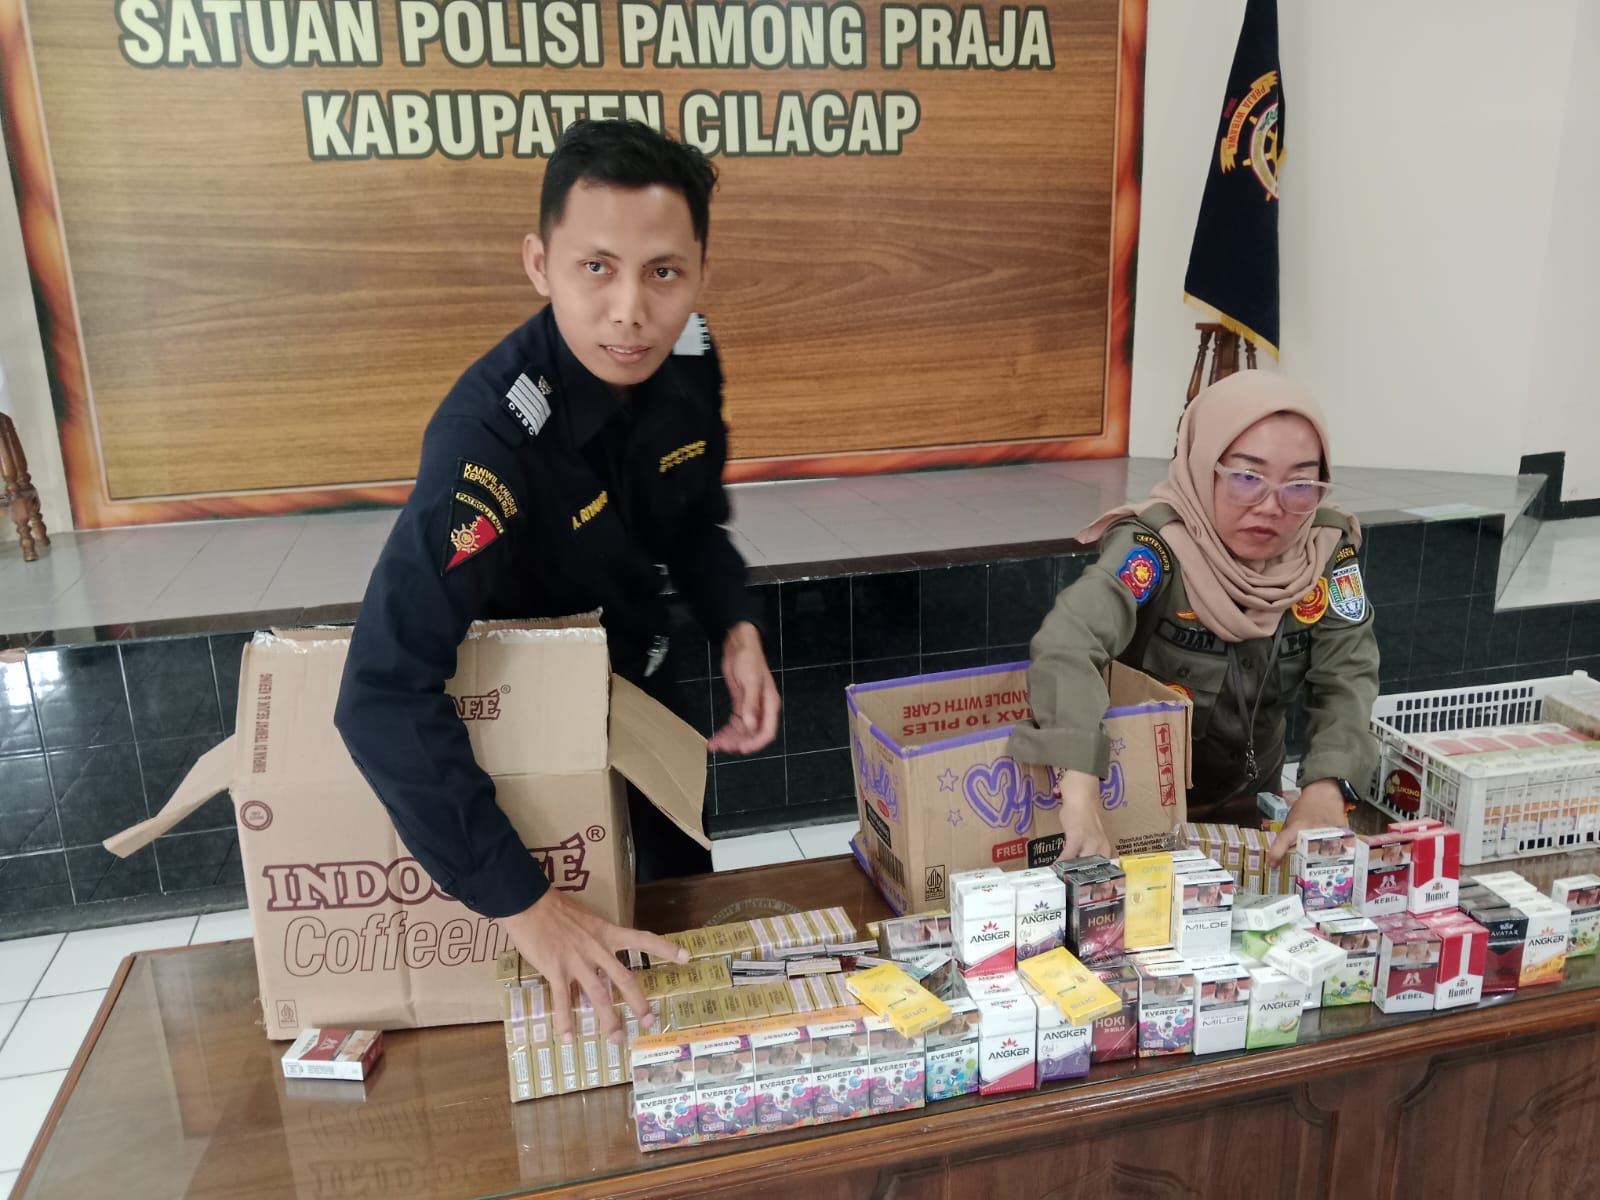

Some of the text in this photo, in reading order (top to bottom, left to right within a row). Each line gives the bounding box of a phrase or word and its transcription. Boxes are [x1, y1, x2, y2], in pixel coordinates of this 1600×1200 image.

[118, 0, 1055, 70] SATUAN POLISI PAMONG PRAJA
[1242, 84, 1267, 109] PRAJA
[681, 90, 921, 157] CILACAP
[1226, 112, 1247, 150] WIBAWA
[465, 462, 499, 487] KANWIL
[463, 471, 504, 503] KEPULAUAN
[258, 673, 273, 695] KERING
[256, 701, 271, 720] SEJUK
[903, 689, 1029, 719] NDLE WITH CARE
[902, 708, 1033, 736] AX 10 PILES
[254, 721, 270, 744] TEMPAT
[996, 843, 1024, 859] FREE
[261, 831, 590, 911] INDOÉ
[1374, 896, 1400, 905] REBEL
[1021, 911, 1062, 925] ANGKER
[1087, 912, 1115, 928] HOKI
[1185, 921, 1229, 931] MILDE
[970, 930, 1010, 944] ANGKER
[1528, 935, 1565, 947] ANGKER
[283, 910, 518, 979] Coffeem
[1395, 992, 1424, 1001] REBEL
[1145, 1008, 1179, 1018] EVEREST
[1259, 1000, 1301, 1012] ANGKER
[1095, 1015, 1126, 1029] HOKI
[1202, 1015, 1245, 1027] MILDE
[1043, 1028, 1088, 1041] ANGKER
[930, 1049, 964, 1062] EVEREST
[988, 1047, 1030, 1061] ANGKER
[873, 1062, 909, 1073] EVEREST
[816, 1070, 853, 1081] EVEREST
[759, 1078, 796, 1090] EVEREST
[701, 1088, 738, 1099] EVEREST
[640, 1097, 678, 1109] EVEREST
